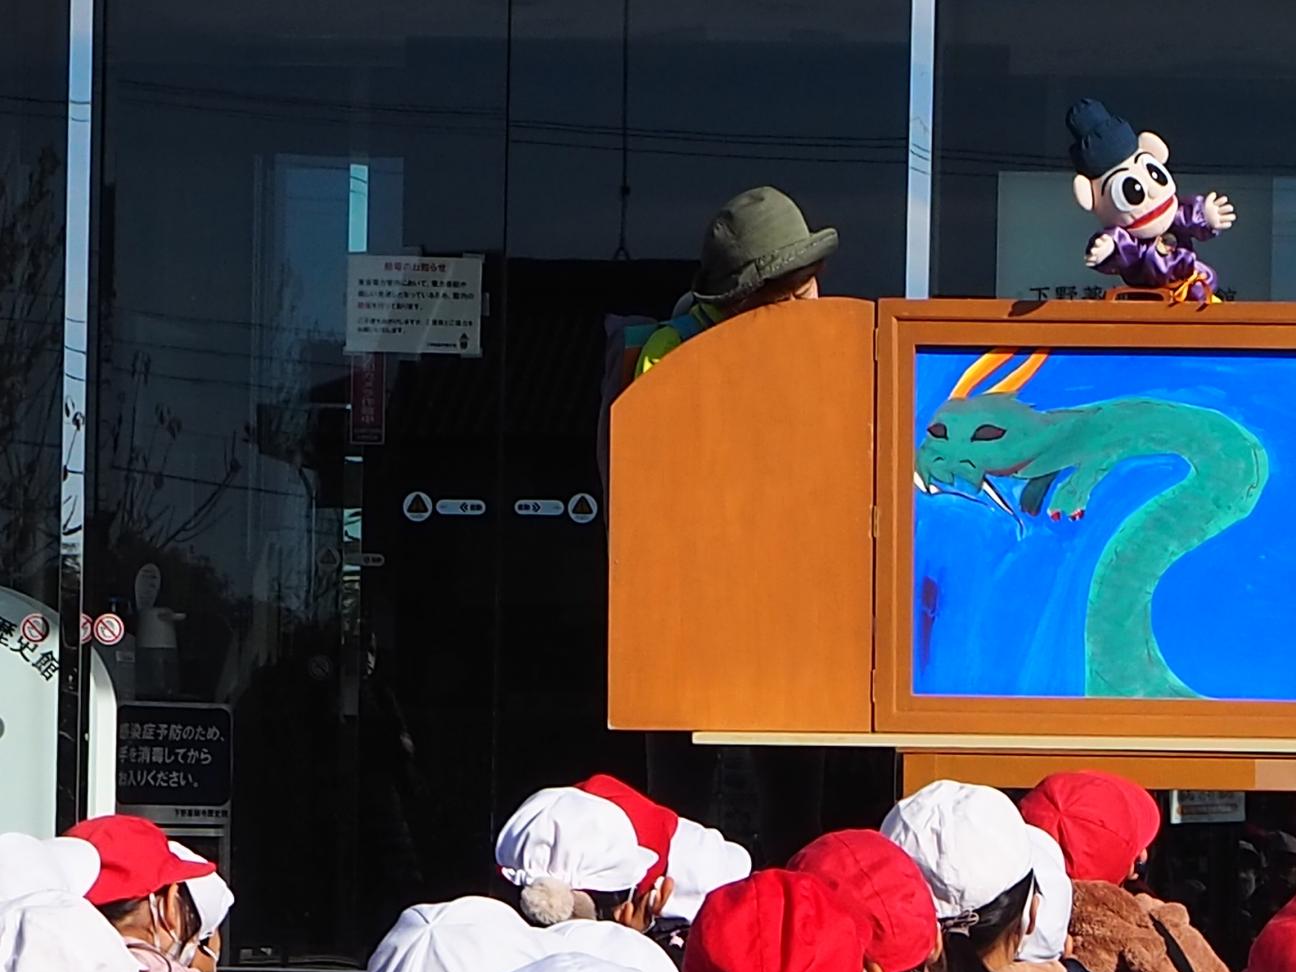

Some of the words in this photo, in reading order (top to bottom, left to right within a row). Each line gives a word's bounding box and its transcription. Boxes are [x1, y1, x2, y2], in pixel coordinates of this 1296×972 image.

[119, 722, 225, 742] 感染症予防のため、
[118, 745, 212, 765] 手を消毒してから
[117, 769, 199, 788] お入りください。
